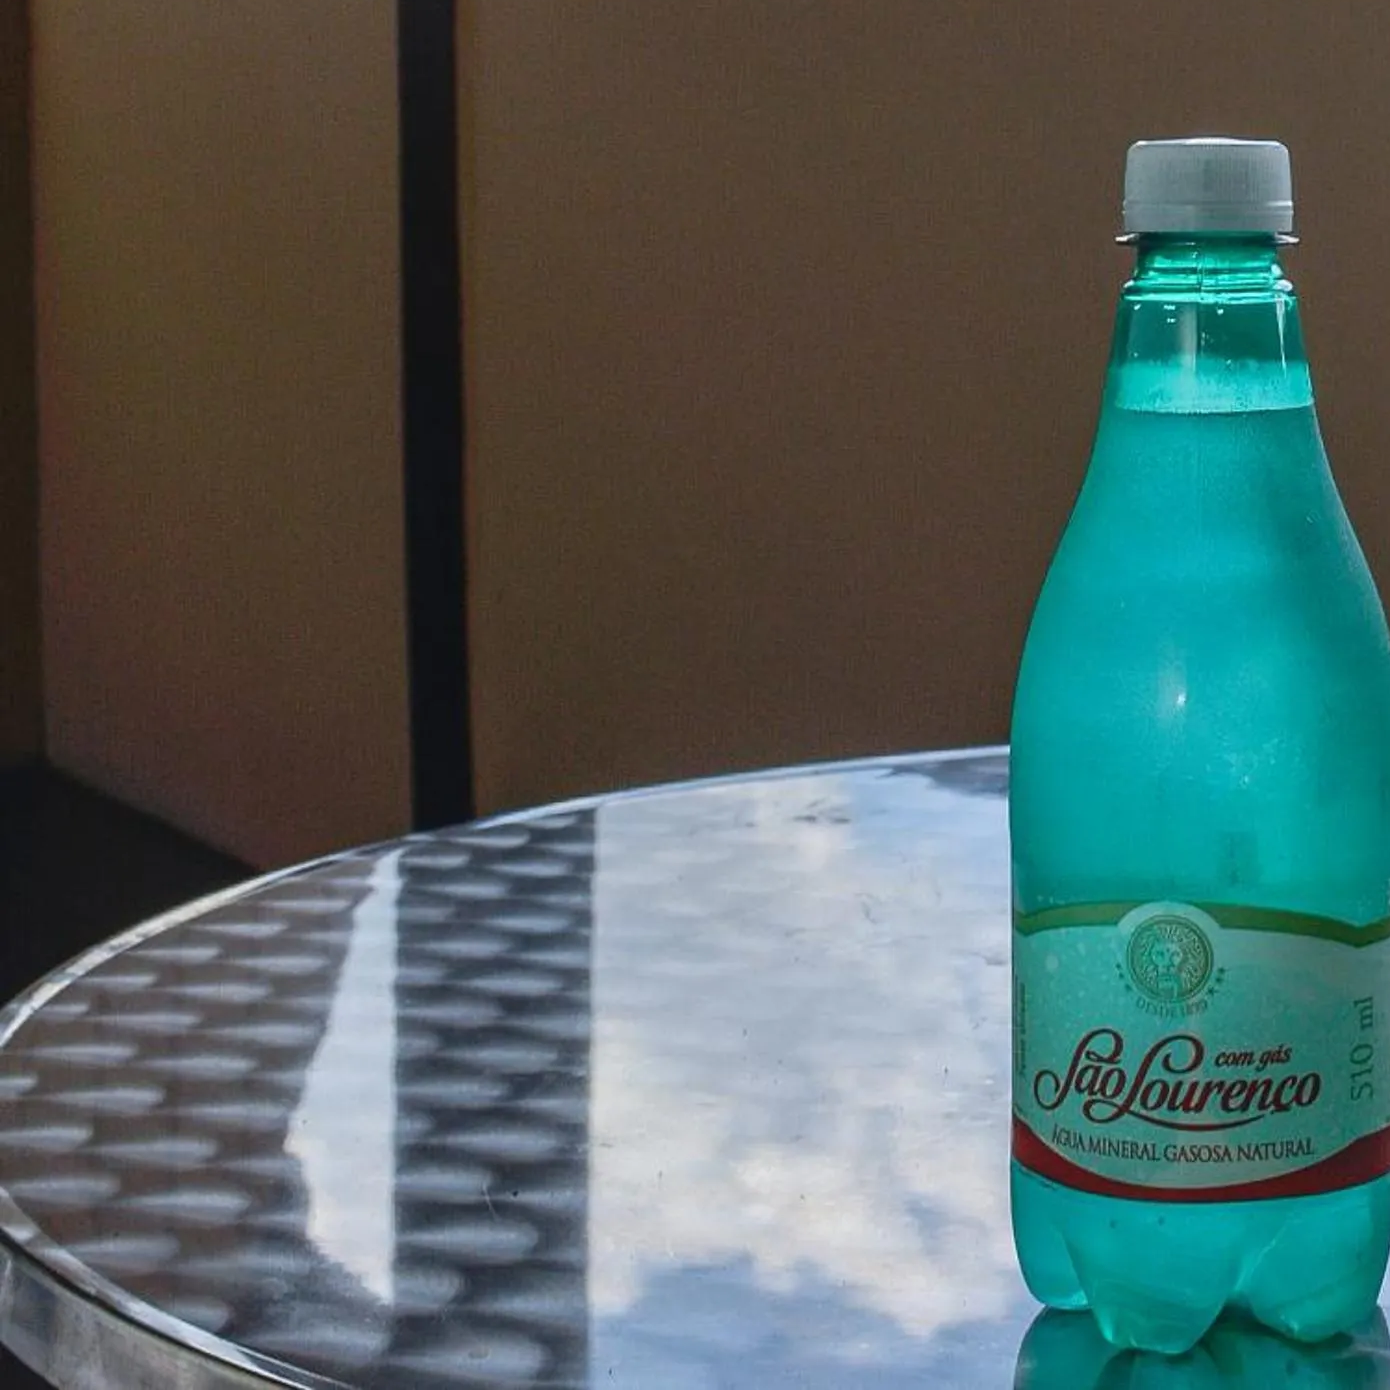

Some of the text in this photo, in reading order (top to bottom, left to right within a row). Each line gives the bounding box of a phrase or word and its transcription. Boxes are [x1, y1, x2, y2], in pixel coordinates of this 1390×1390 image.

[1033, 1028, 1127, 1111] São
[1083, 1035, 1321, 1131] Lourenço
[1214, 1043, 1293, 1072] com gás
[1351, 996, 1374, 1101] 510 ml
[1088, 1135, 1161, 1162] MINERAL
[1163, 1143, 1233, 1163] GASOSA
[1236, 1137, 1315, 1161] NATURAL
